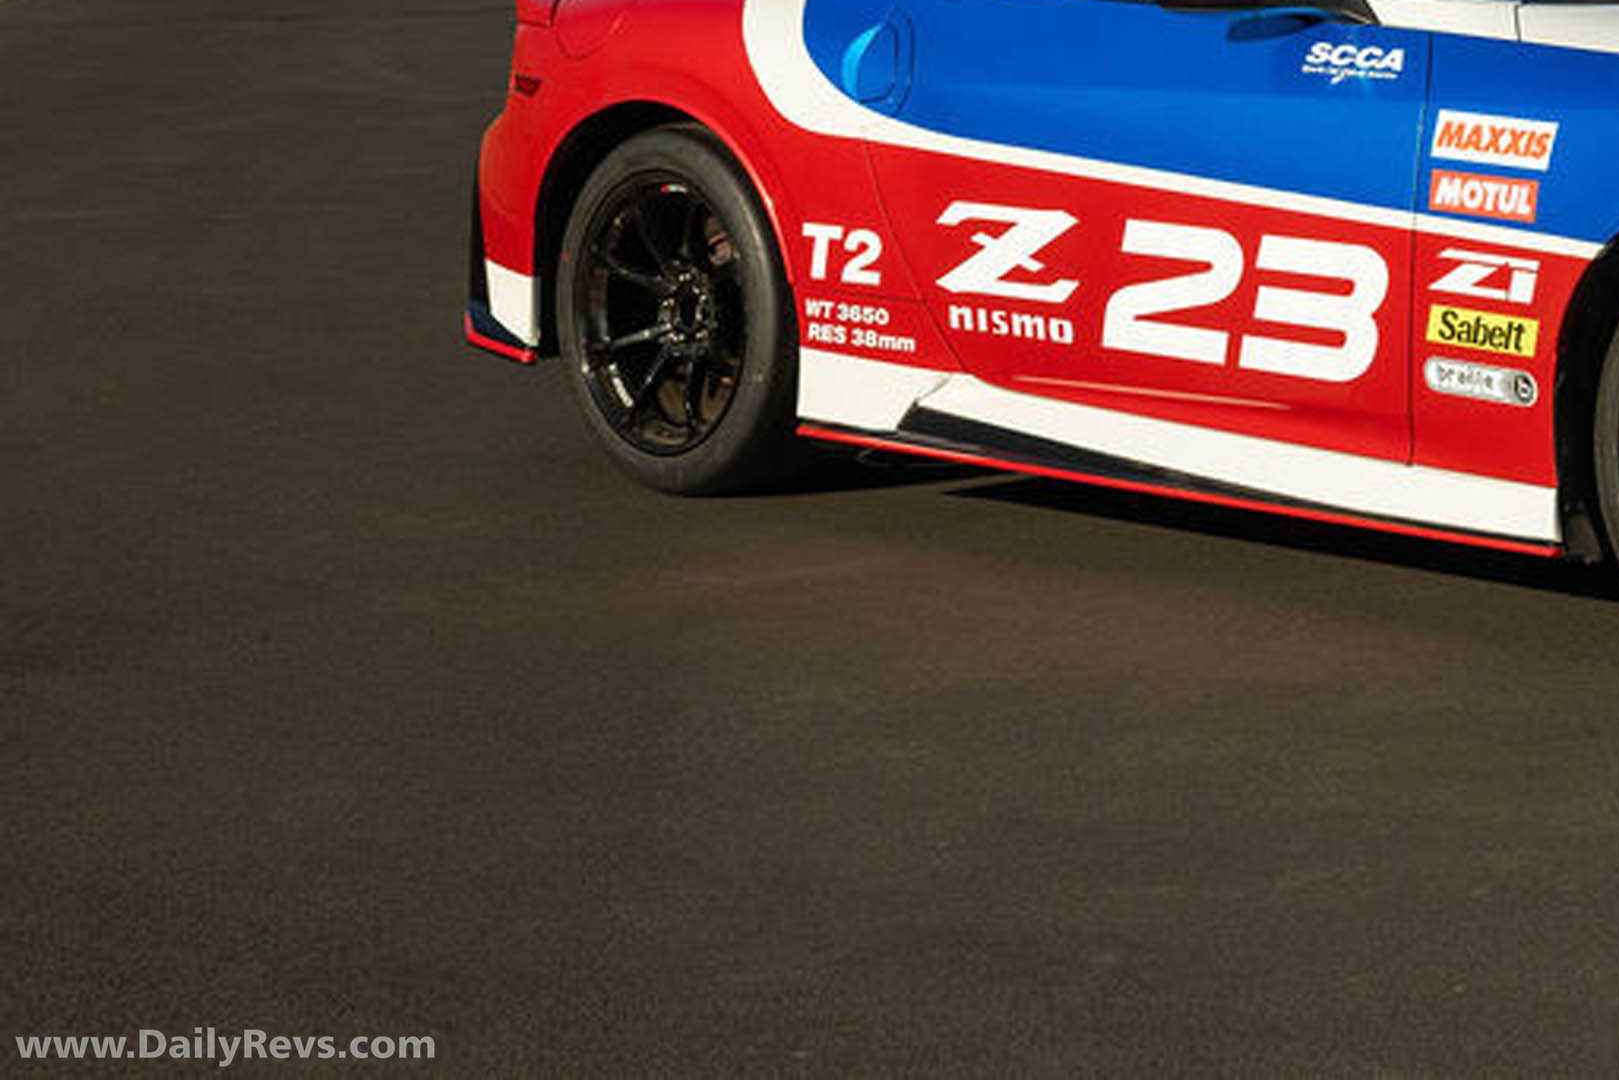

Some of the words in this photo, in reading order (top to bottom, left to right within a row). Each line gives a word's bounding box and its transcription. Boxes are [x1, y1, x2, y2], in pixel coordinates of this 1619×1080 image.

[1304, 41, 1405, 72] SCCA
[1436, 120, 1552, 161] MAXXIS
[1434, 176, 1531, 215] MOTUL
[801, 222, 883, 287] T2
[805, 298, 835, 319] WT
[1102, 218, 1390, 383] 23
[808, 322, 847, 345] RES
[851, 328, 917, 353] 38mm
[1437, 309, 1527, 353] Sabelt
